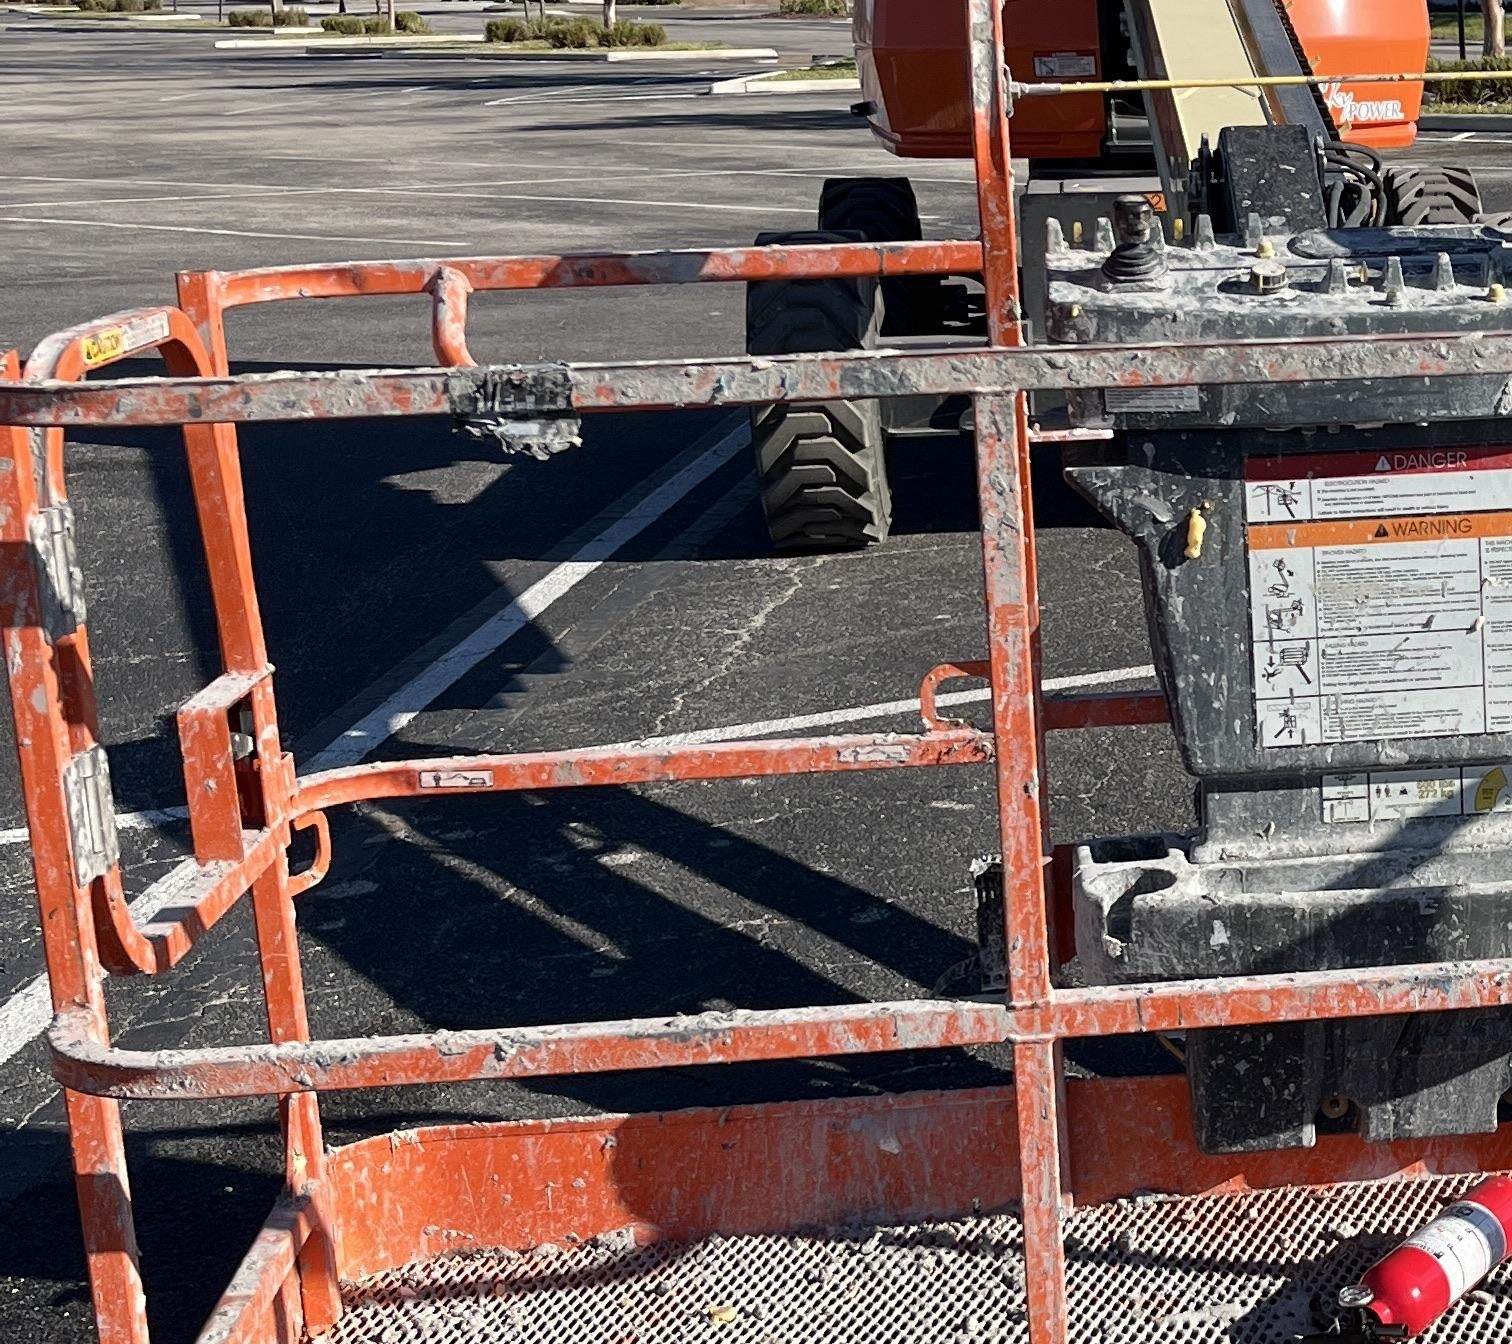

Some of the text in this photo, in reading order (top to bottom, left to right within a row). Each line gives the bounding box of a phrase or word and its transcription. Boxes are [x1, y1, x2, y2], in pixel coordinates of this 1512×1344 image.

[1347, 100, 1404, 121] POWER
[1394, 451, 1468, 470] DANGER
[1391, 518, 1473, 537] WARNING
